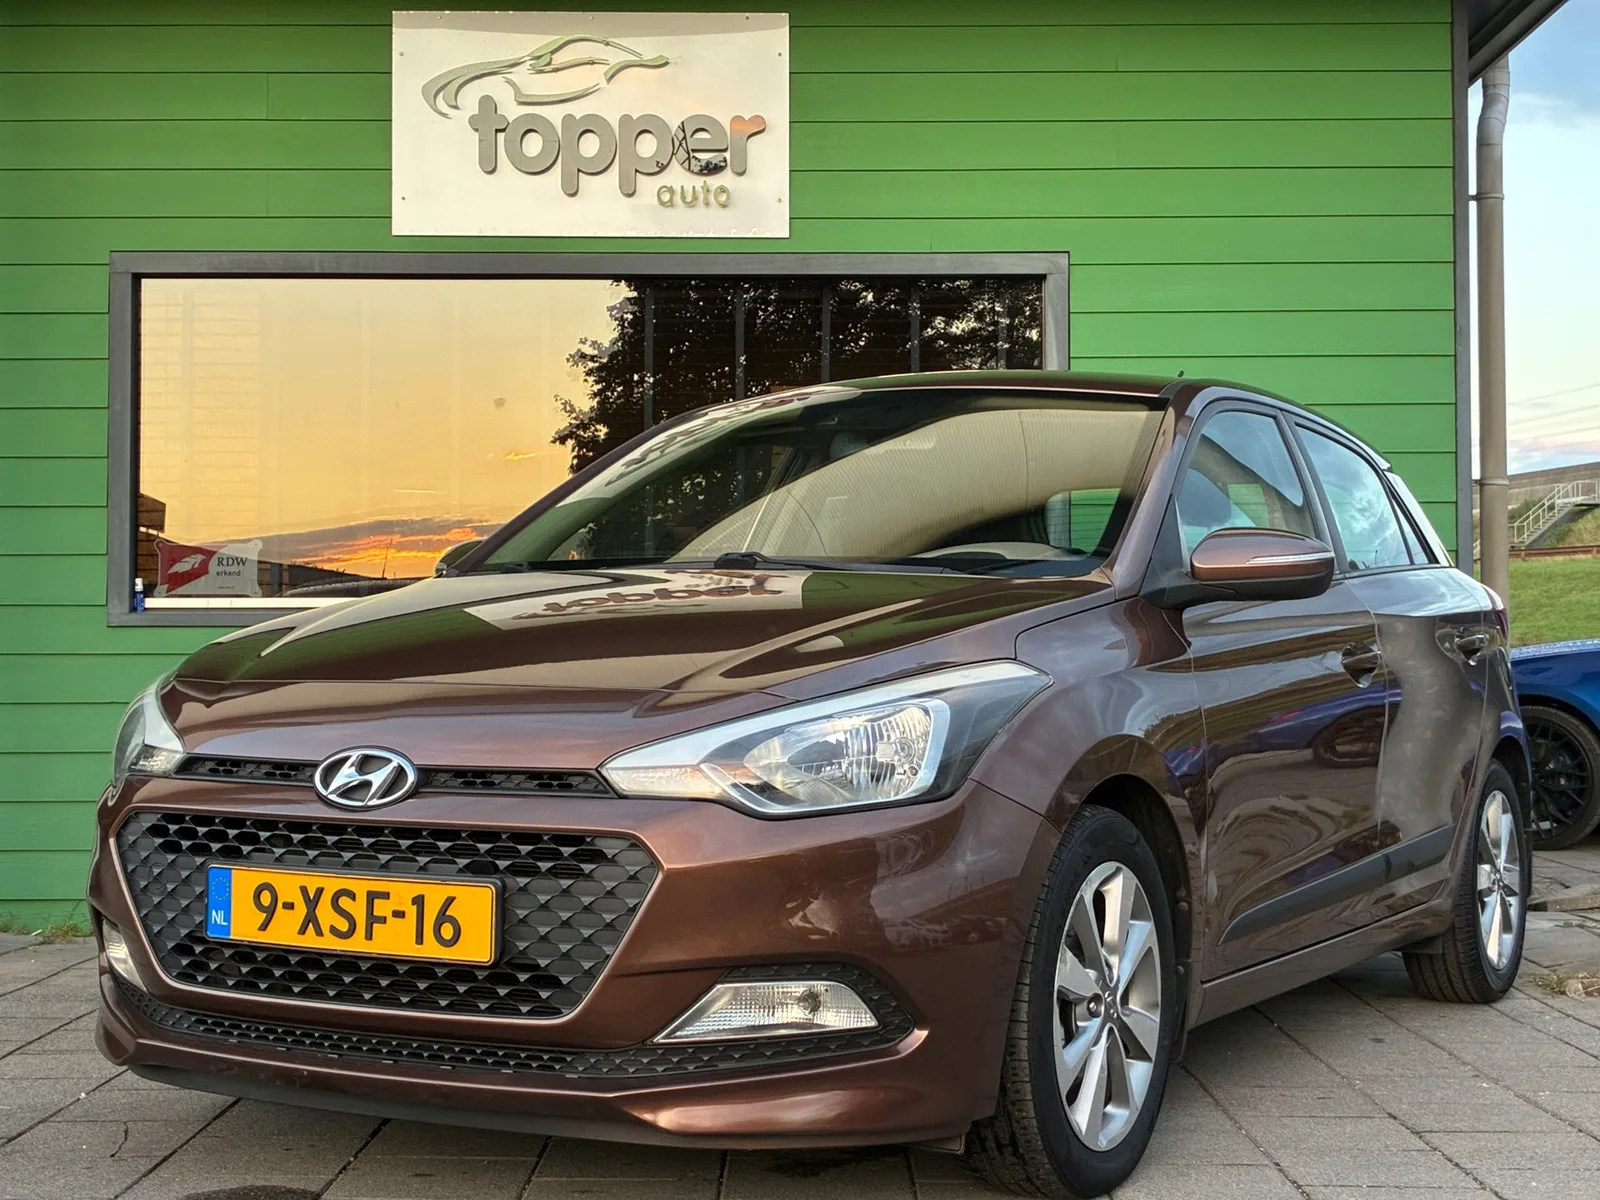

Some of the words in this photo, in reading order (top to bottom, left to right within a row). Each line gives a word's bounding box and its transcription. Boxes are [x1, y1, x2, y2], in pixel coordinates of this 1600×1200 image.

[468, 94, 767, 198] topper
[656, 180, 731, 208] auto
[216, 556, 248, 567] RDW
[216, 568, 241, 577] erkend
[211, 909, 229, 926] NL
[252, 881, 462, 948] 9-XSF-16
